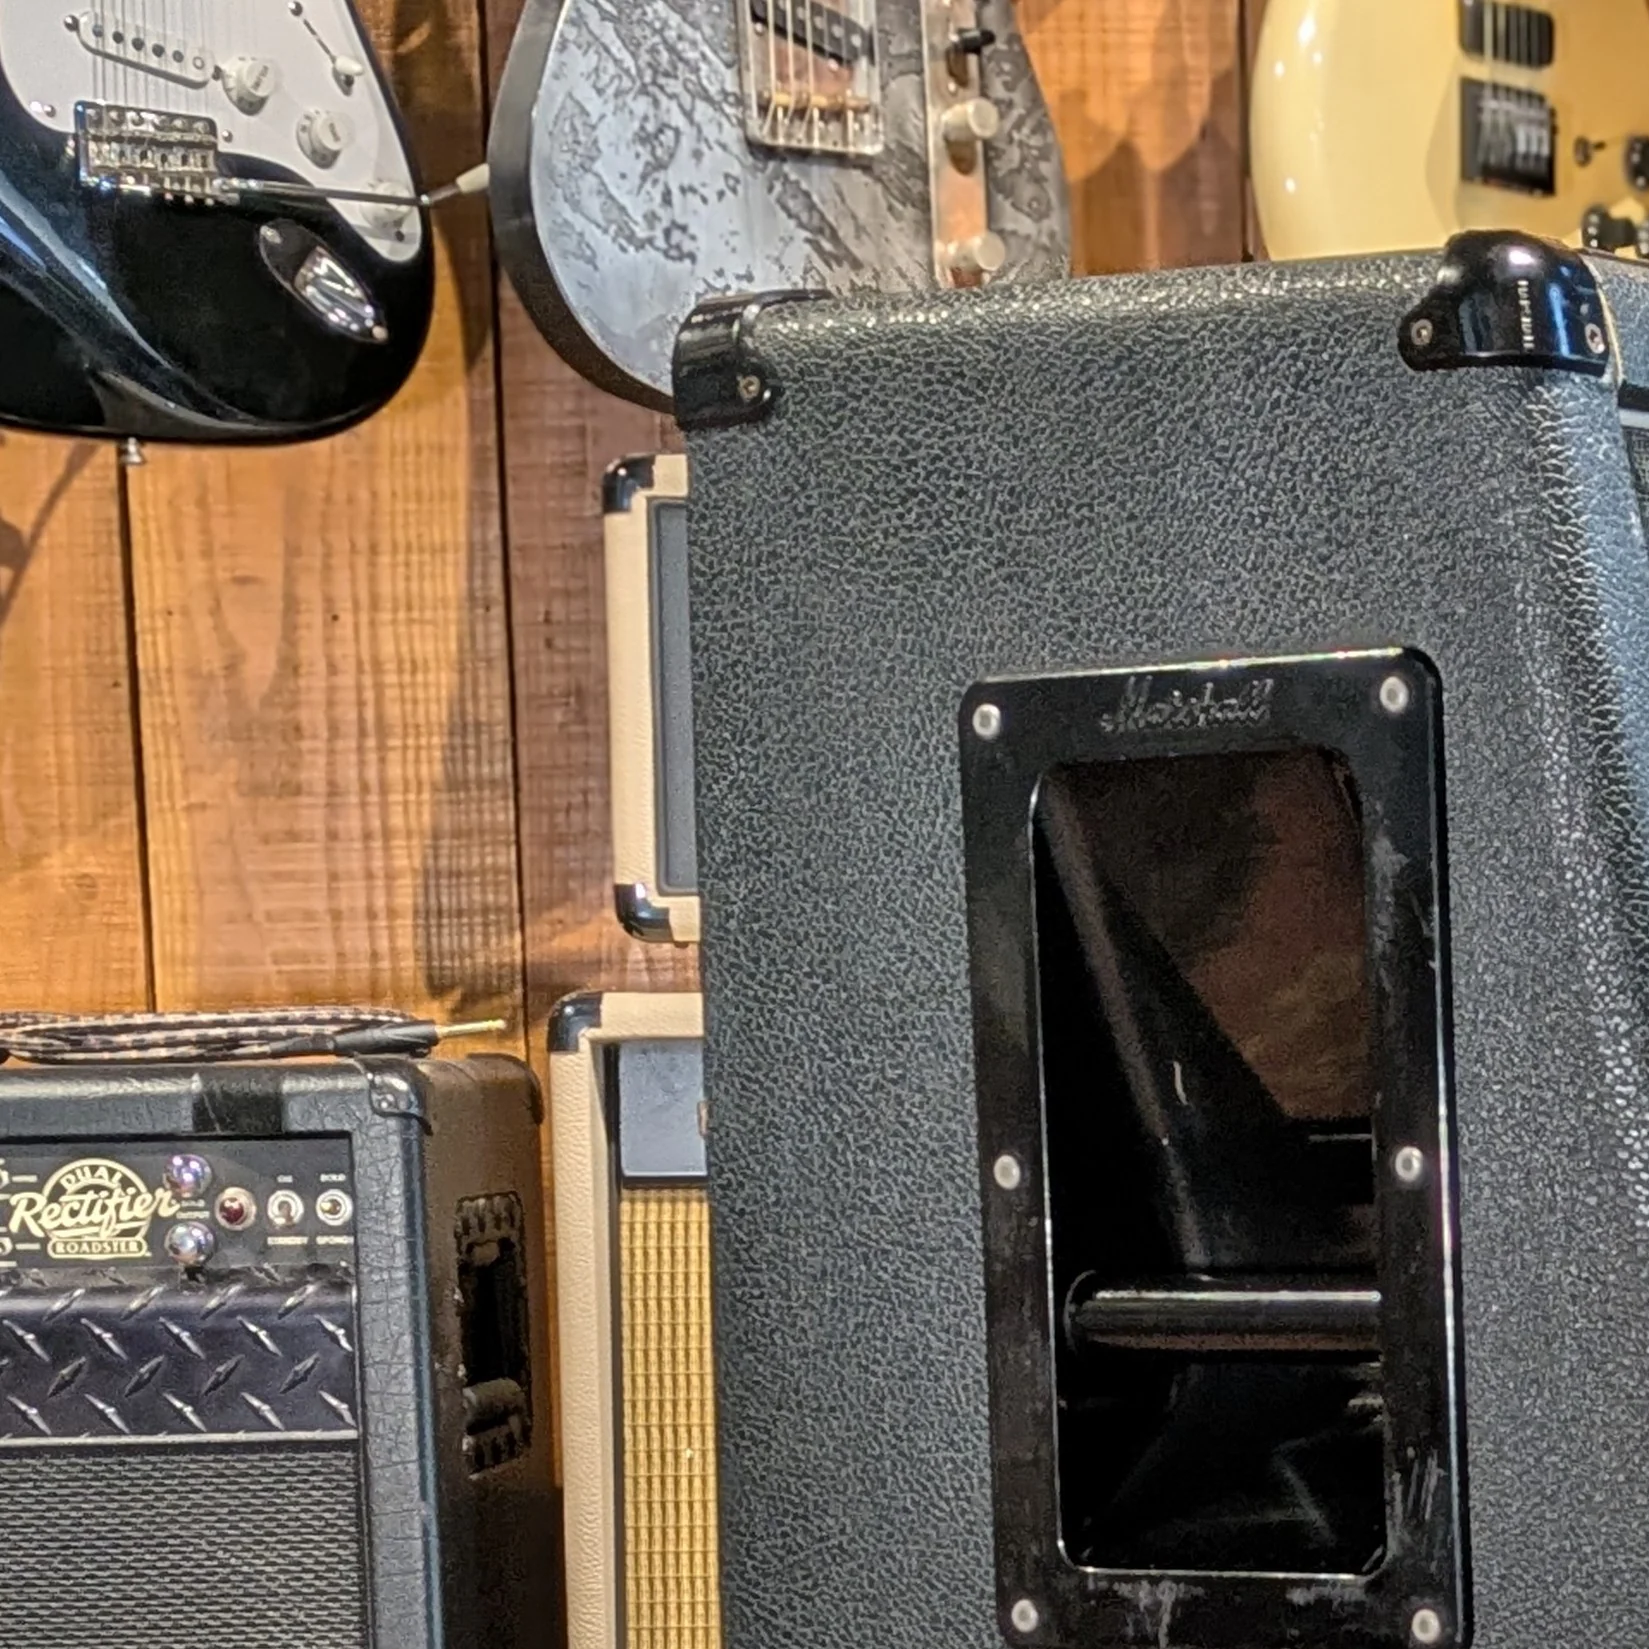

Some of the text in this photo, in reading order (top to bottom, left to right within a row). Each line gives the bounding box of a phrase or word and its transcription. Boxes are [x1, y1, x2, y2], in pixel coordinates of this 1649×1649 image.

[1101, 675, 1274, 733] Marshall
[60, 1166, 123, 1190] DUAL
[9, 1187, 180, 1238] Rectifier
[55, 1241, 139, 1254] ROADSTER
